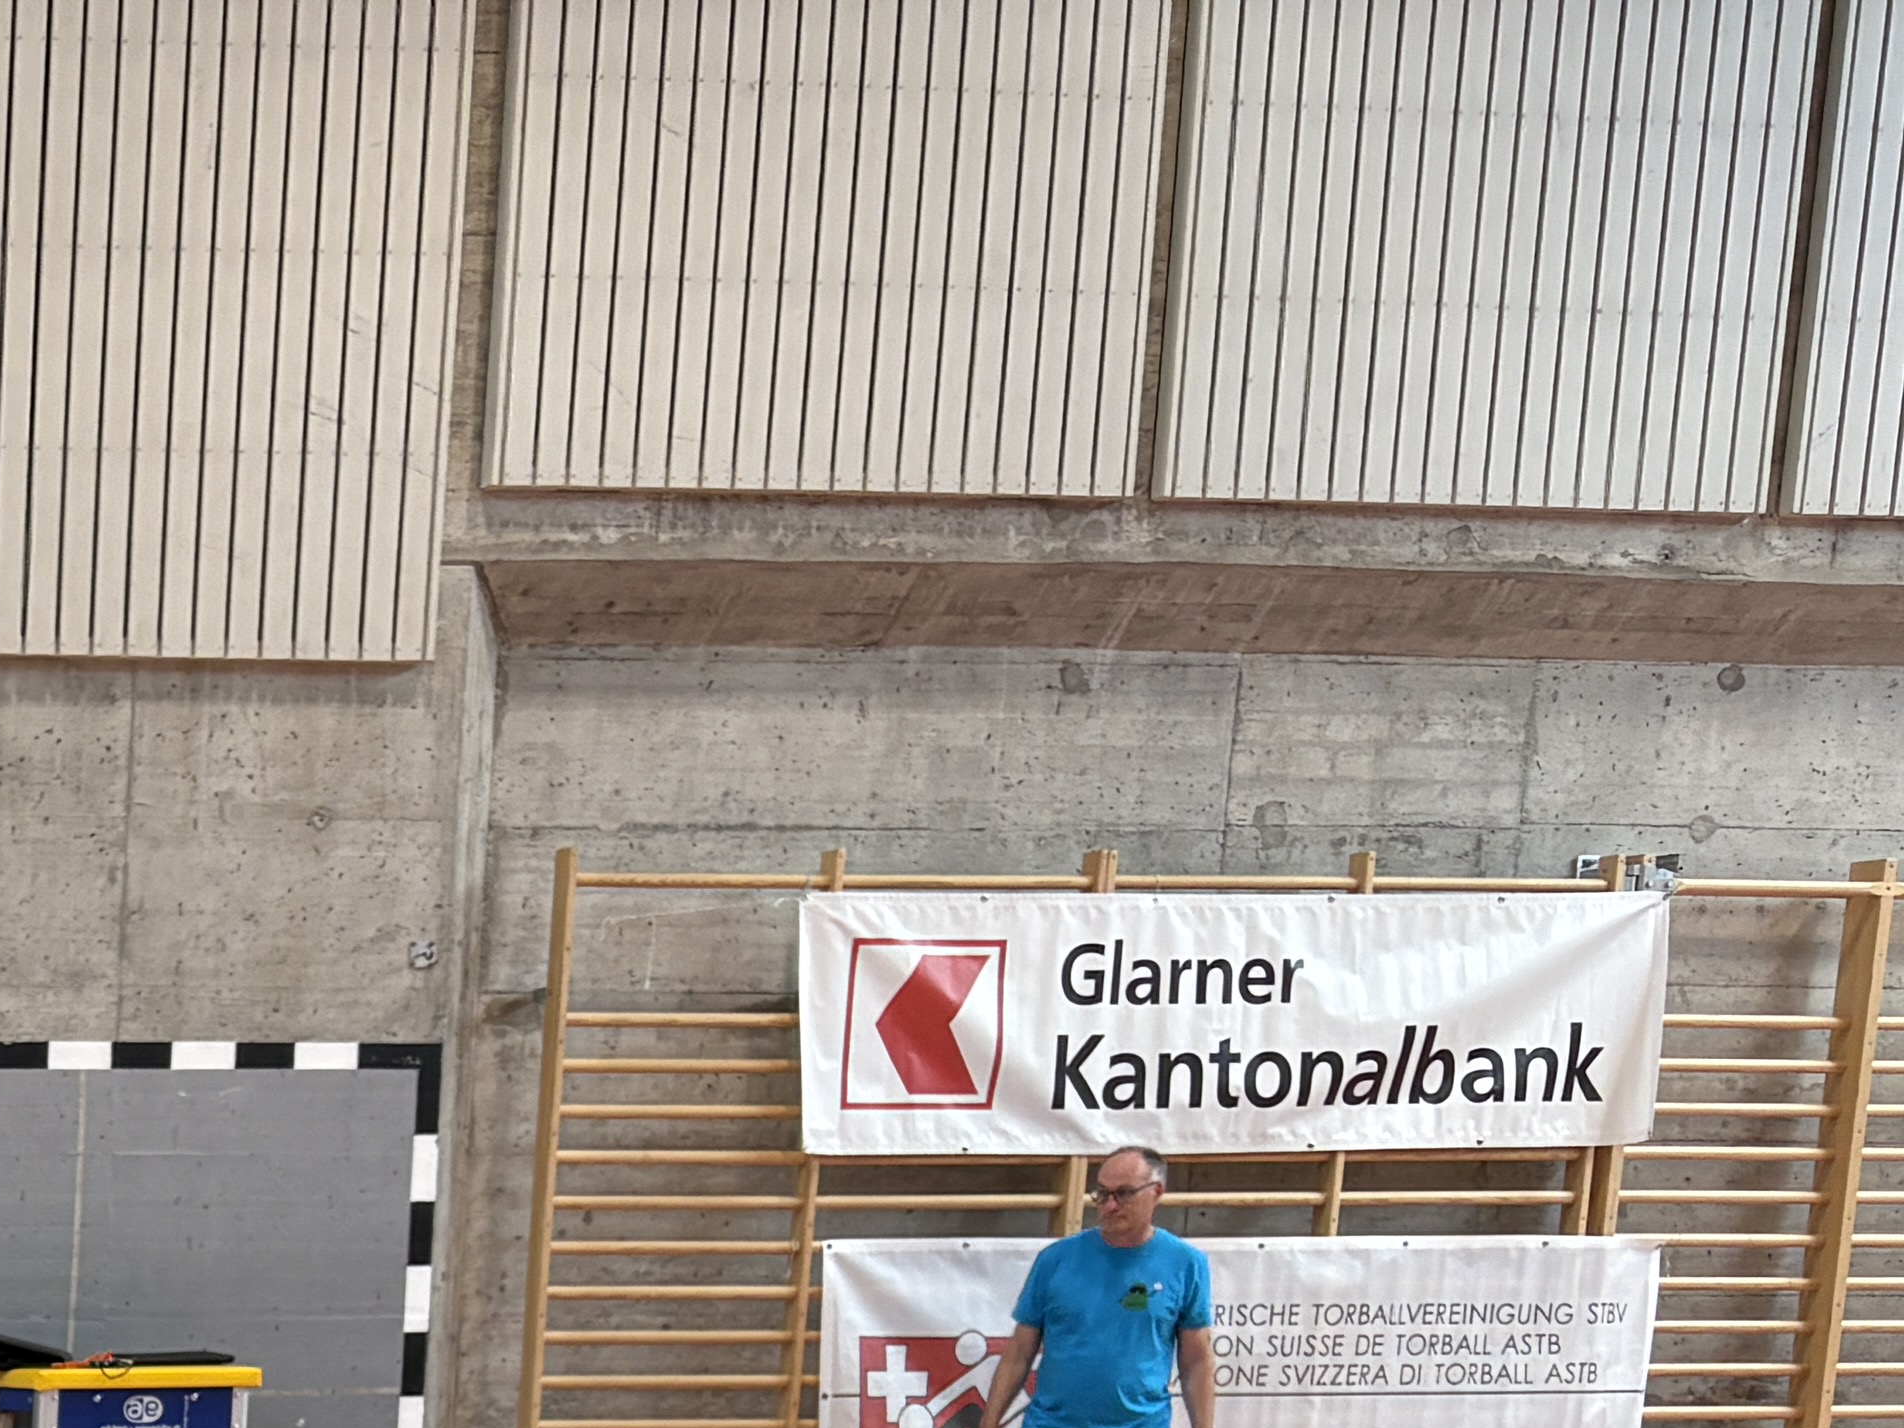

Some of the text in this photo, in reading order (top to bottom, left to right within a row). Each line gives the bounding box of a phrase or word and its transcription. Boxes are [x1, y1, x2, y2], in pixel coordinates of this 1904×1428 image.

[1061, 939, 1305, 1006] Glarner
[1051, 1022, 1605, 1111] Kantonalbank
[1313, 1302, 1575, 1327] TORBALLVEREINIGUNG
[1586, 1301, 1628, 1324] STBV
[1265, 1334, 1345, 1358] SUISSE
[1354, 1335, 1384, 1357] DE
[1395, 1334, 1492, 1357] TORBALL
[1500, 1334, 1562, 1356] ASTB
[1278, 1362, 1389, 1387] SVIZZERA
[1399, 1363, 1423, 1386] DI
[1433, 1363, 1534, 1386] TORBALL
[1544, 1362, 1599, 1385] ASTB
